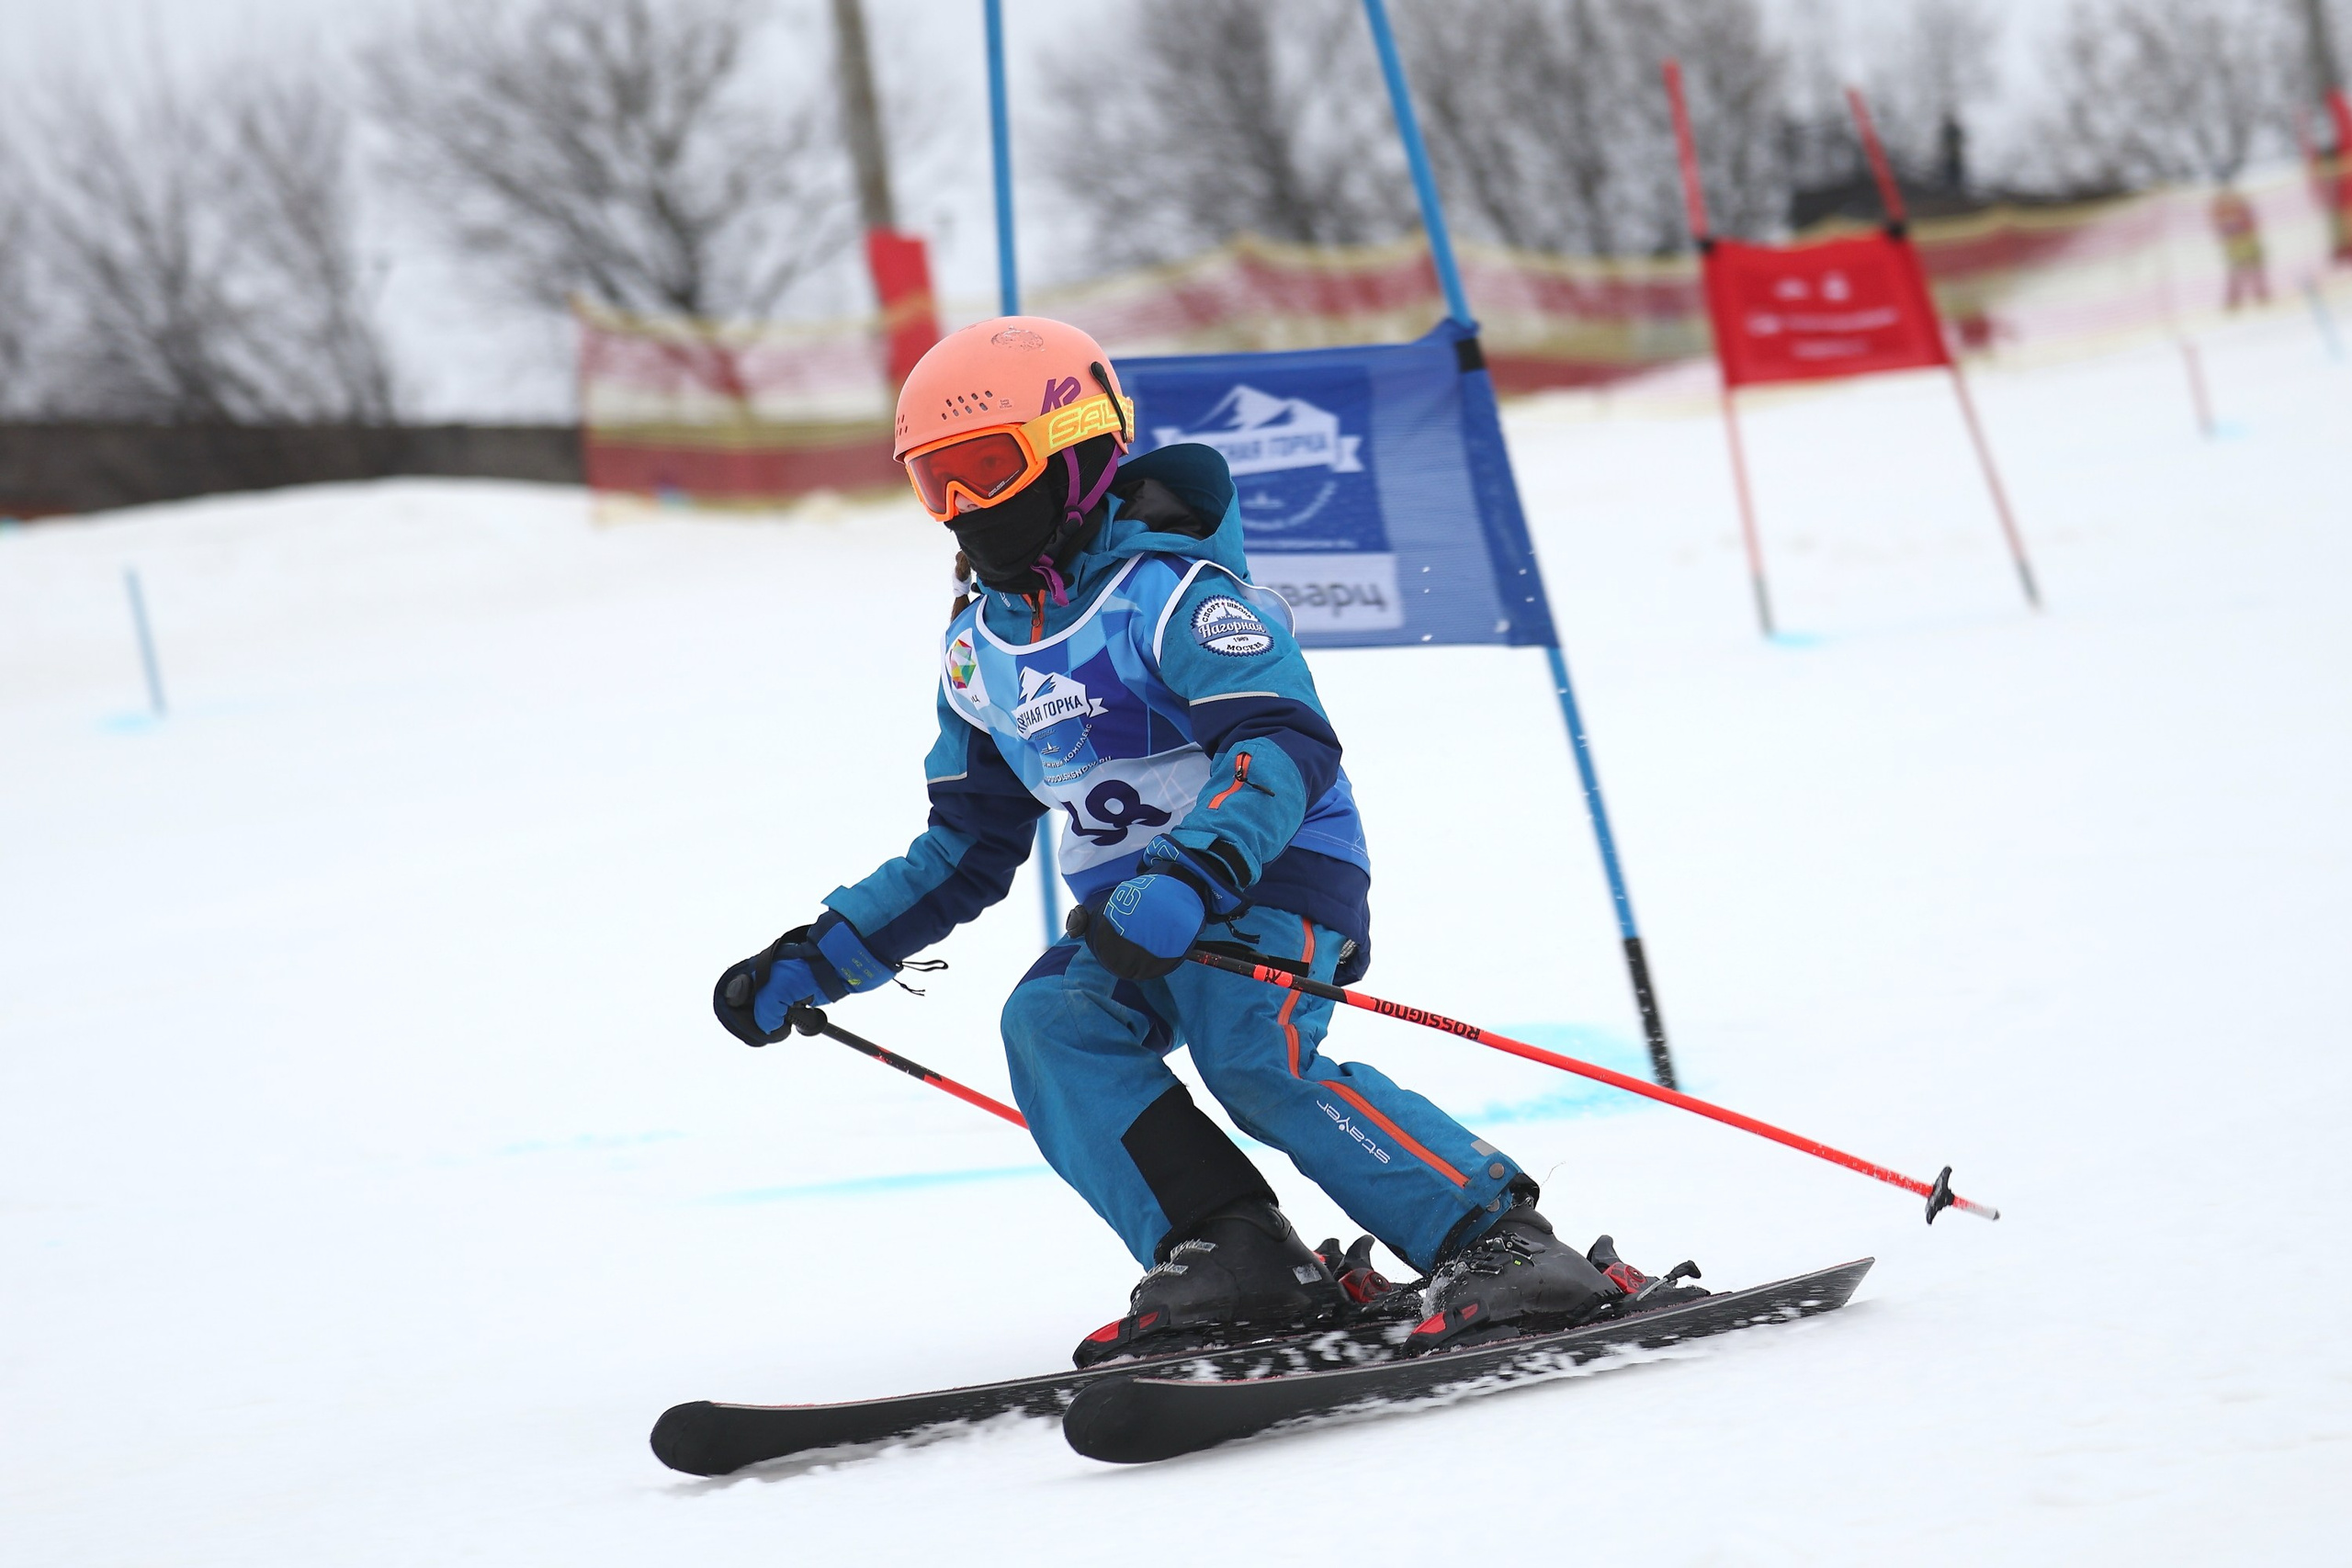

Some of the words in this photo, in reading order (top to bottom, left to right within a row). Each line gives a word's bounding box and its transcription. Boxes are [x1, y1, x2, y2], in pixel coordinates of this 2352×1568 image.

[1049, 399, 1126, 448] SAL
[1198, 621, 1267, 639] Нагорная
[1202, 603, 1221, 623] СПОРТ
[1043, 694, 1084, 719] ГОРКА
[1063, 723, 1093, 763] КОМПЛЕКС
[1370, 996, 1481, 1041] ROSSIGNOL
[1316, 1099, 1391, 1165] stayer
